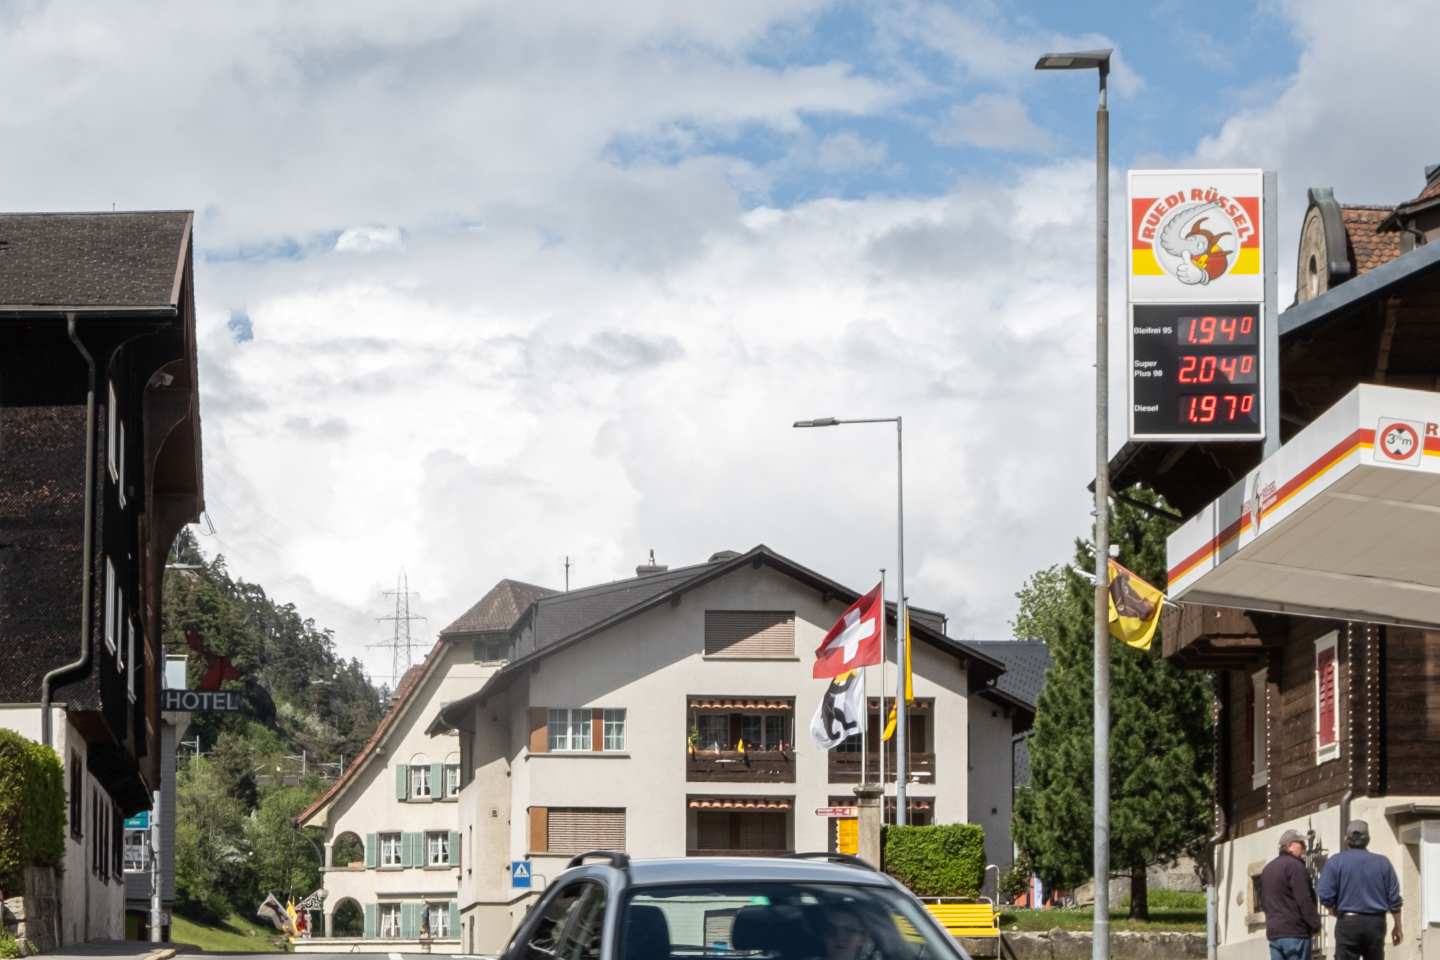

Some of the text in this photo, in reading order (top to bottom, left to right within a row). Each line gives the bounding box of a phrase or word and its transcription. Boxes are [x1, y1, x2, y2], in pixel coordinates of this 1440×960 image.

[1142, 186, 1251, 240] RUEDI RÜSSEL
[1133, 360, 1158, 369] Super
[1133, 369, 1152, 377] Plus
[1133, 404, 1159, 412] Diesel
[166, 691, 240, 711] HOTEL
